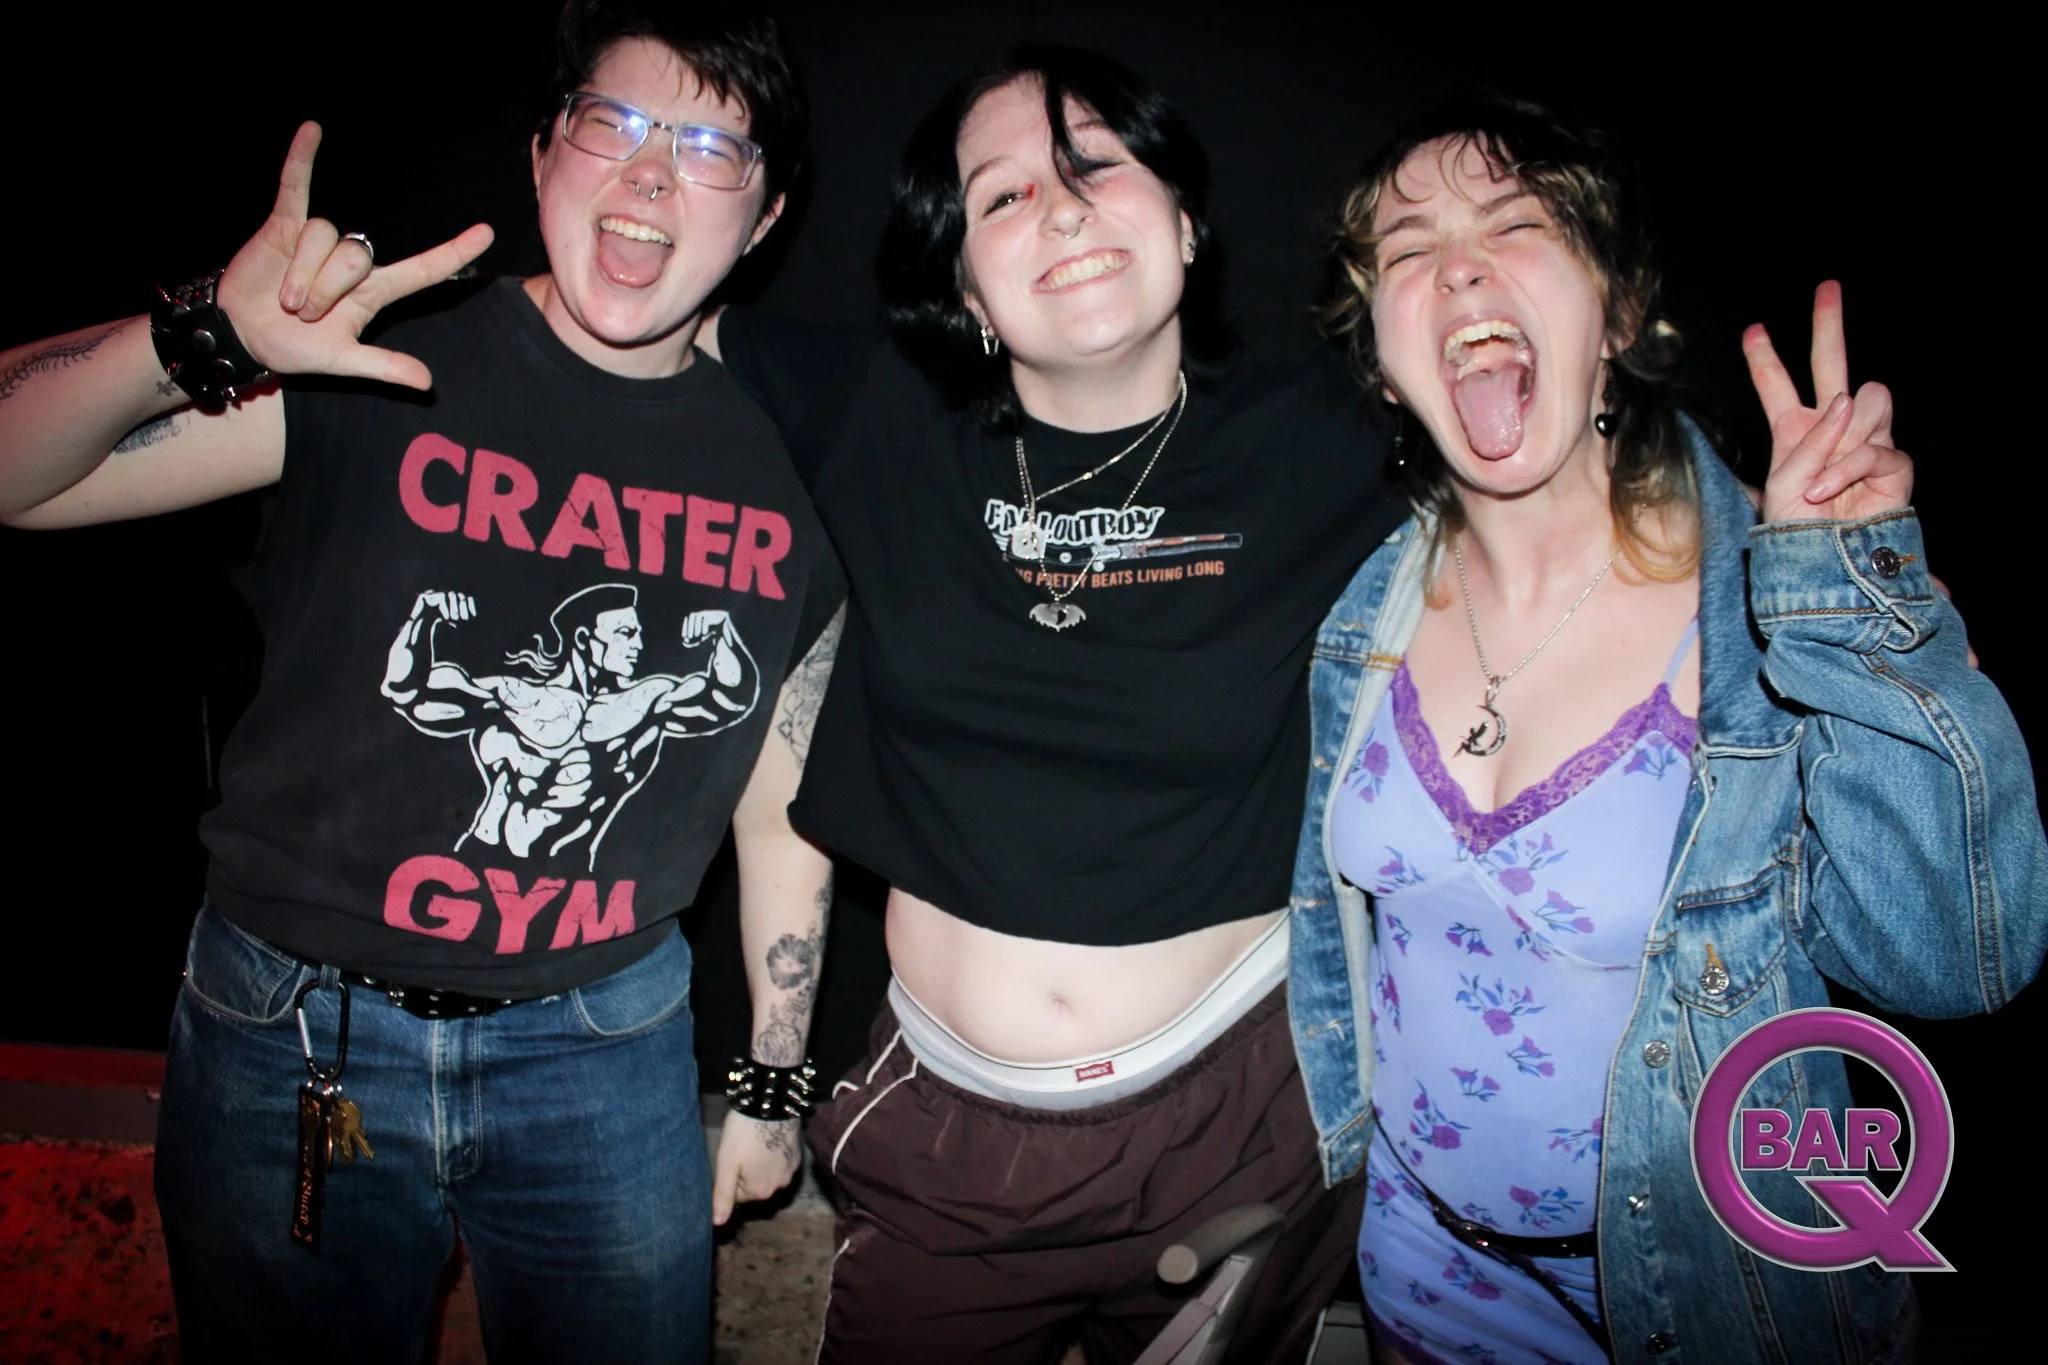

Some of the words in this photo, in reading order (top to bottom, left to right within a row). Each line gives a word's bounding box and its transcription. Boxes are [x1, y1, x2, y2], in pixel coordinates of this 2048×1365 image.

[398, 432, 793, 600] CRATER
[1036, 573, 1087, 588] PRETTY
[1091, 568, 1133, 588] BEATS
[1138, 566, 1182, 582] LIVING
[1187, 560, 1224, 576] LONG
[383, 855, 635, 954] GYM
